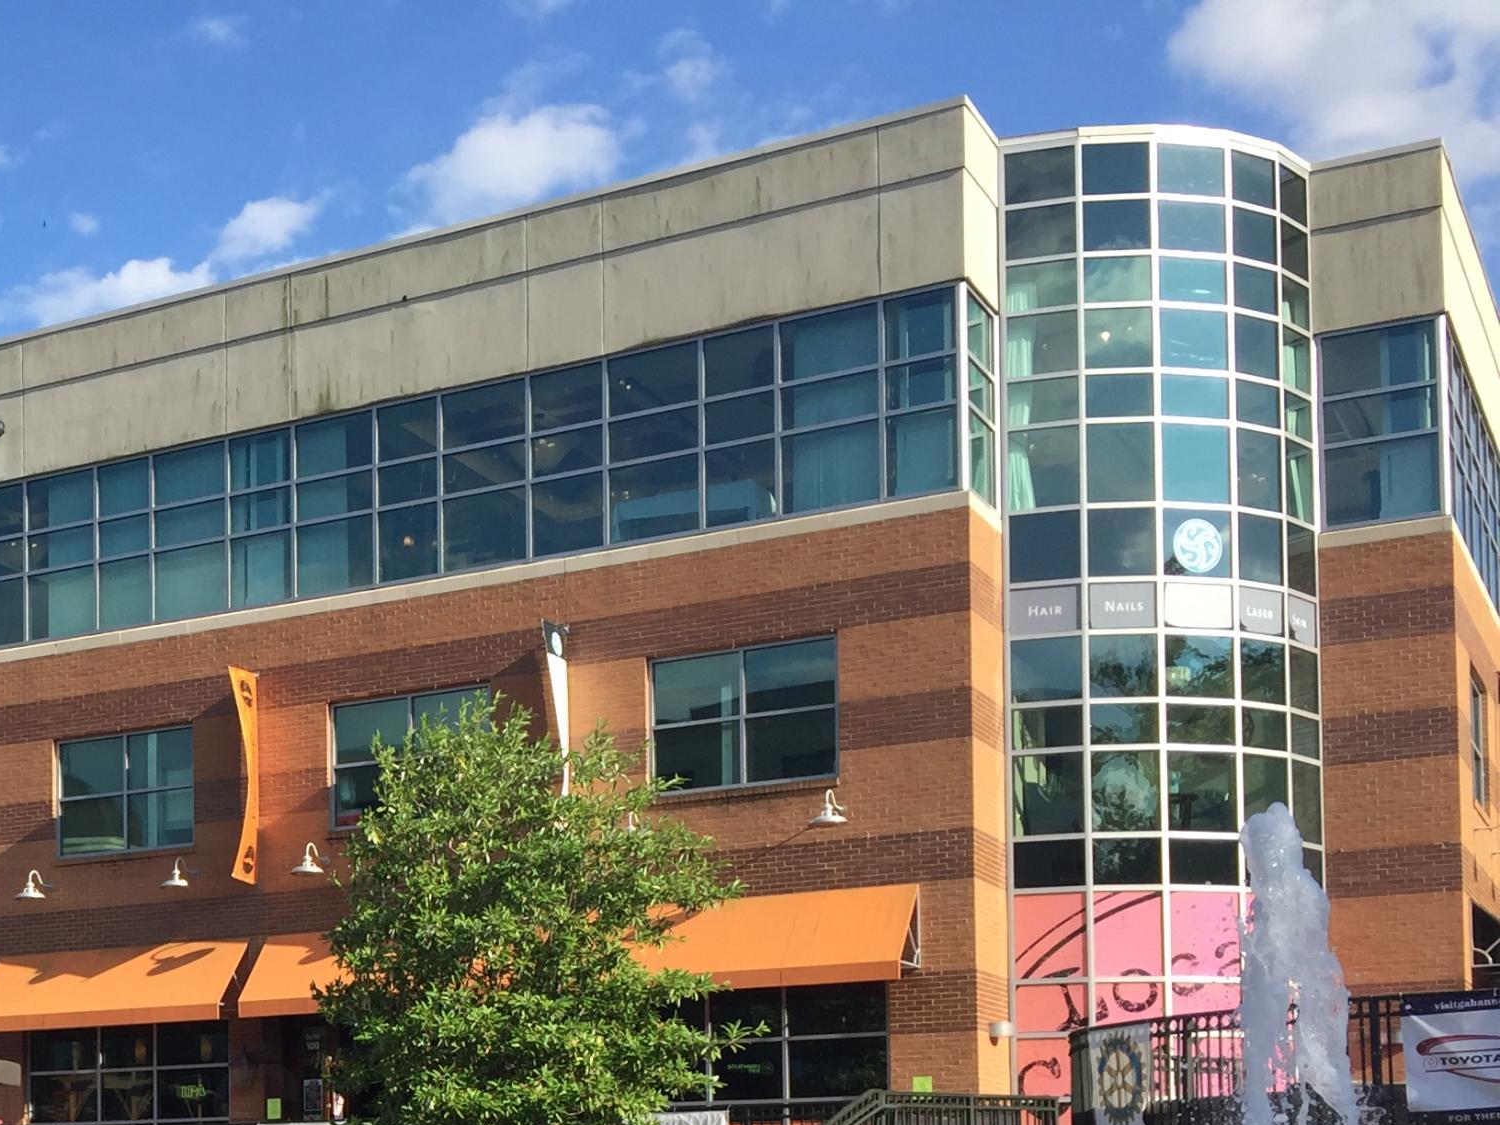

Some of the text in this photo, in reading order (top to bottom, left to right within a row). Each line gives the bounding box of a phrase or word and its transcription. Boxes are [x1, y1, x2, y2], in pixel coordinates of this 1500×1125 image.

[1028, 604, 1063, 617] HAIR
[1104, 600, 1145, 613] NAILS
[1246, 605, 1274, 620] LASER
[1433, 999, 1500, 1010] visitgahann
[1448, 1114, 1472, 1122] FOR
